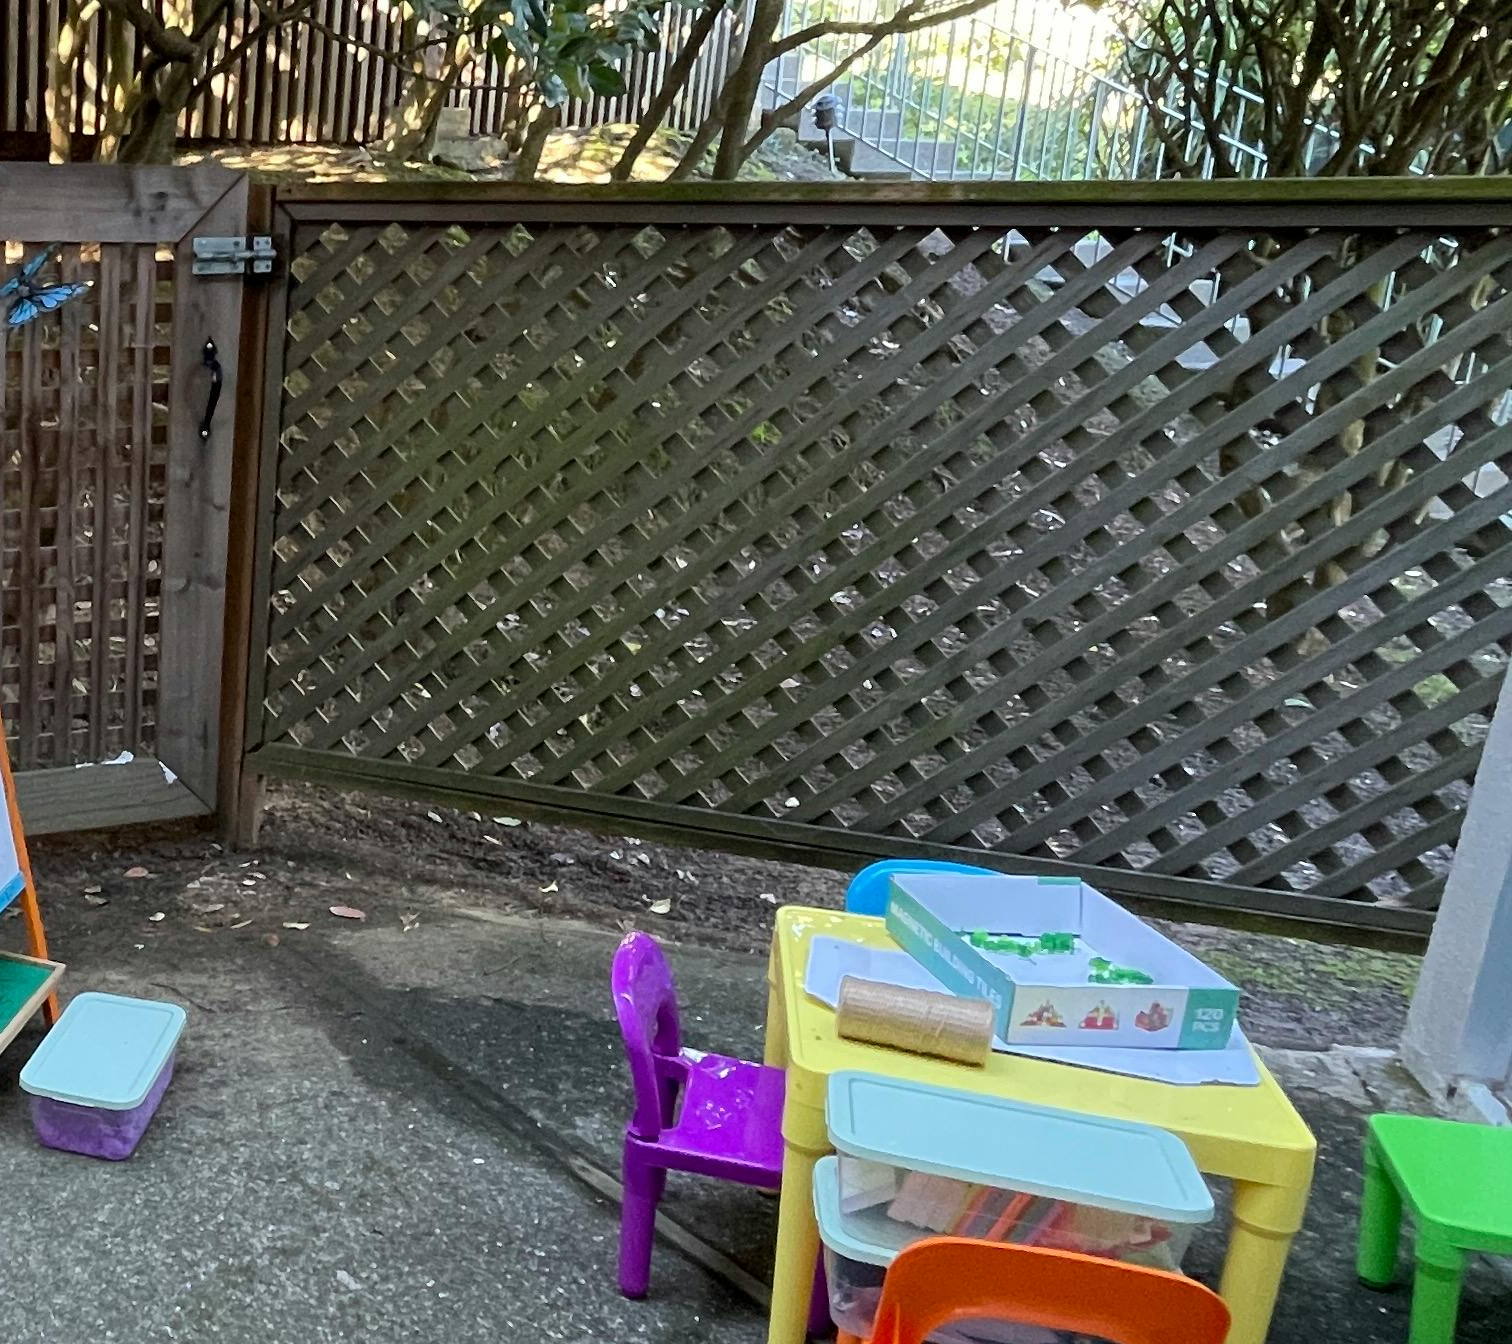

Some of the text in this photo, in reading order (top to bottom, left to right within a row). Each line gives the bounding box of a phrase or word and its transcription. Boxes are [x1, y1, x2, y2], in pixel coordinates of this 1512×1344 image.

[890, 902, 1002, 1009] MAGNETIC BUILDING TILES
[1194, 1008, 1224, 1020] 120
[1191, 1021, 1220, 1032] PCS
